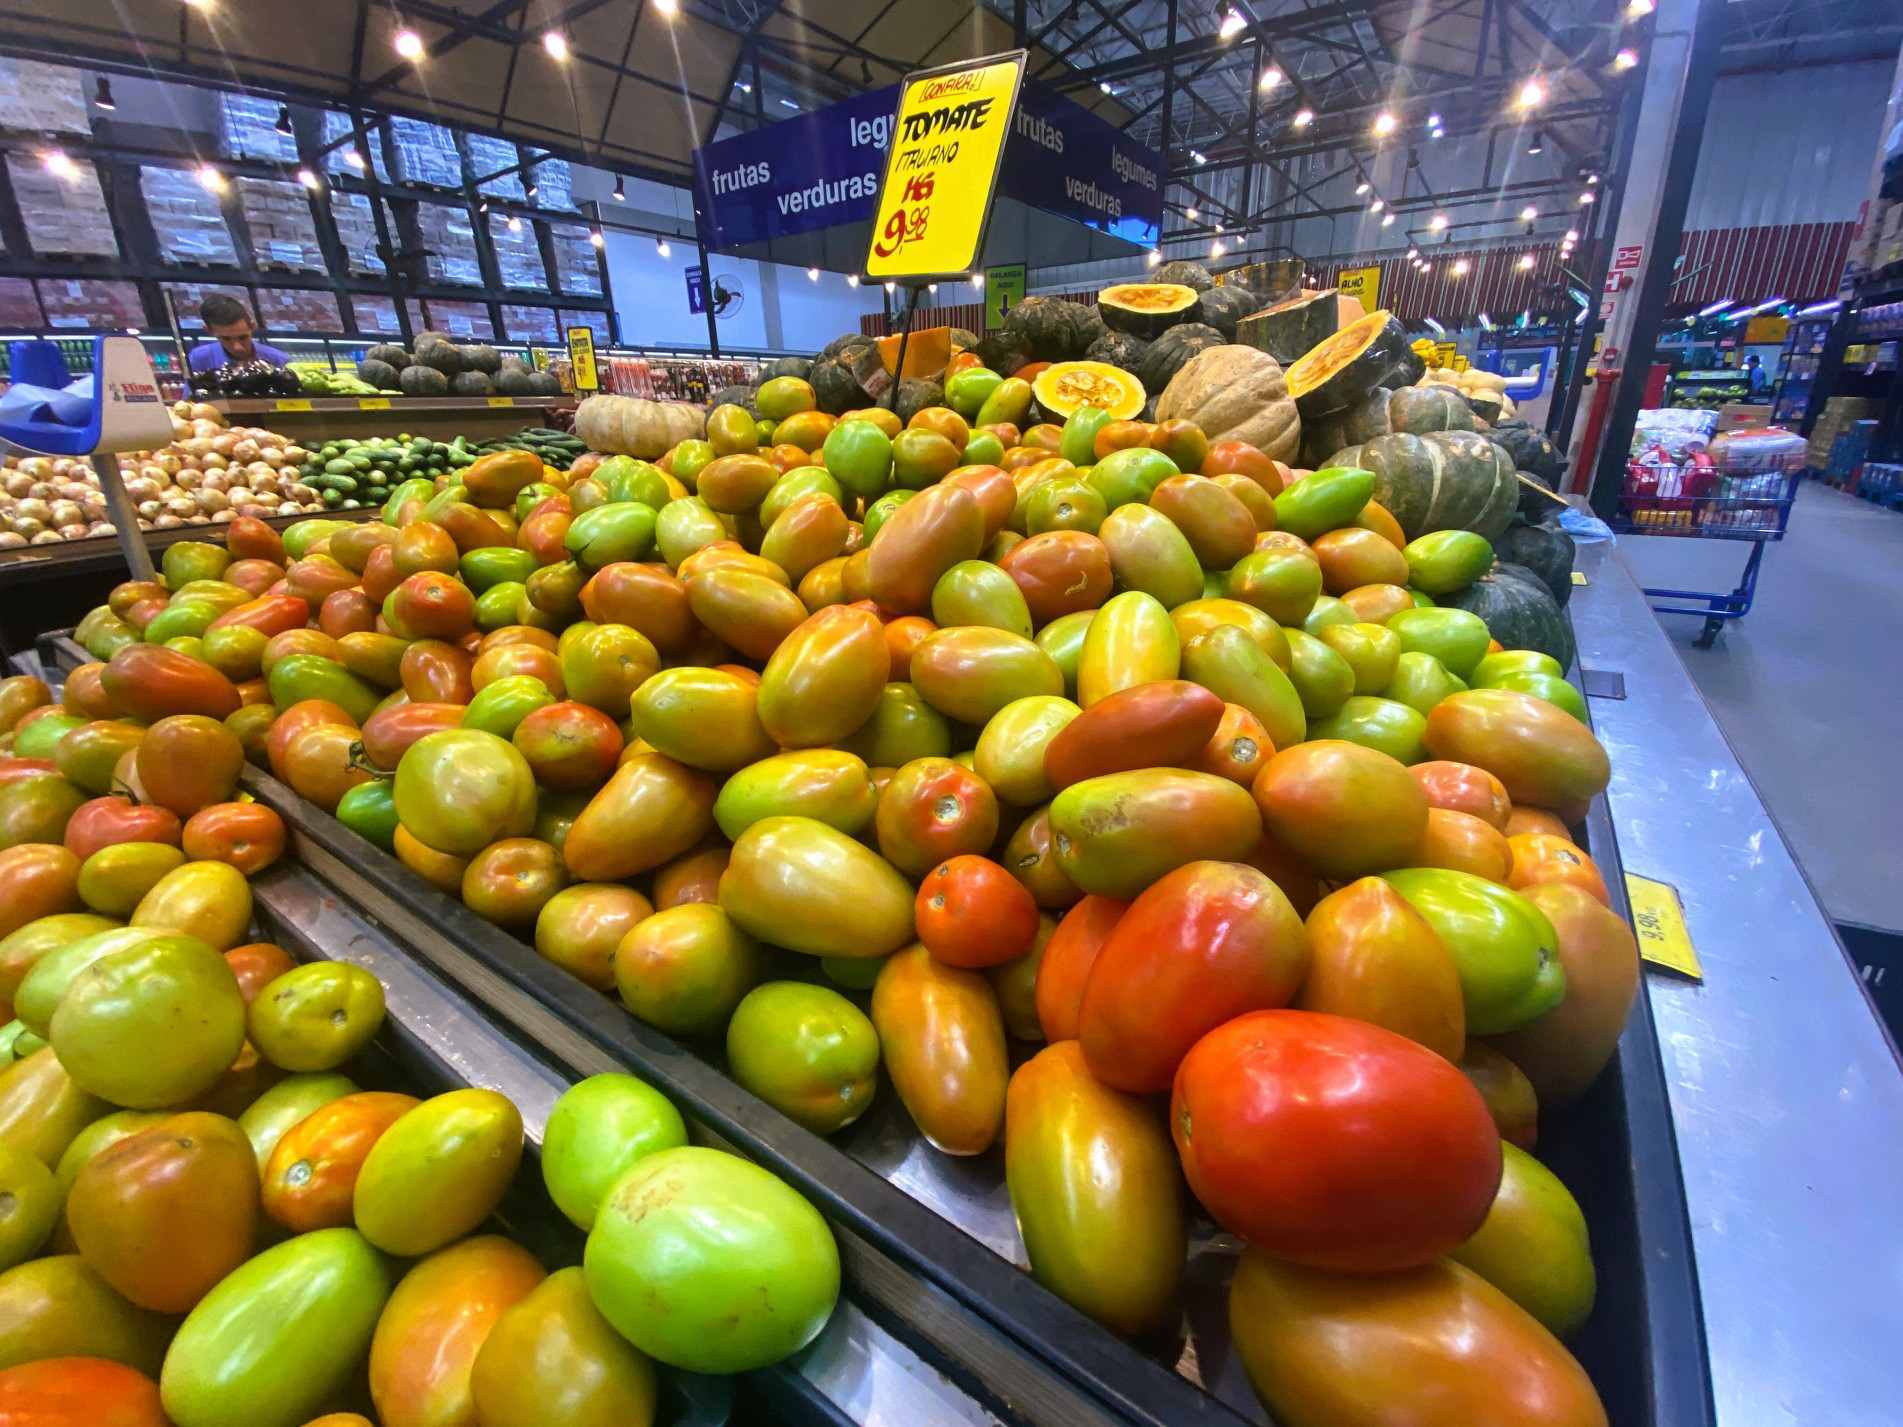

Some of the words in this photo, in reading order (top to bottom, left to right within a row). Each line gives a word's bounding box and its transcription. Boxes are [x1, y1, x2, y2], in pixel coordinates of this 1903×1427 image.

[901, 97, 996, 144] TOMATE
[1017, 104, 1064, 153] frutas
[712, 161, 771, 195] frutas
[1112, 144, 1157, 191] legumes
[777, 172, 877, 215] verduras
[1065, 175, 1122, 217] verduras
